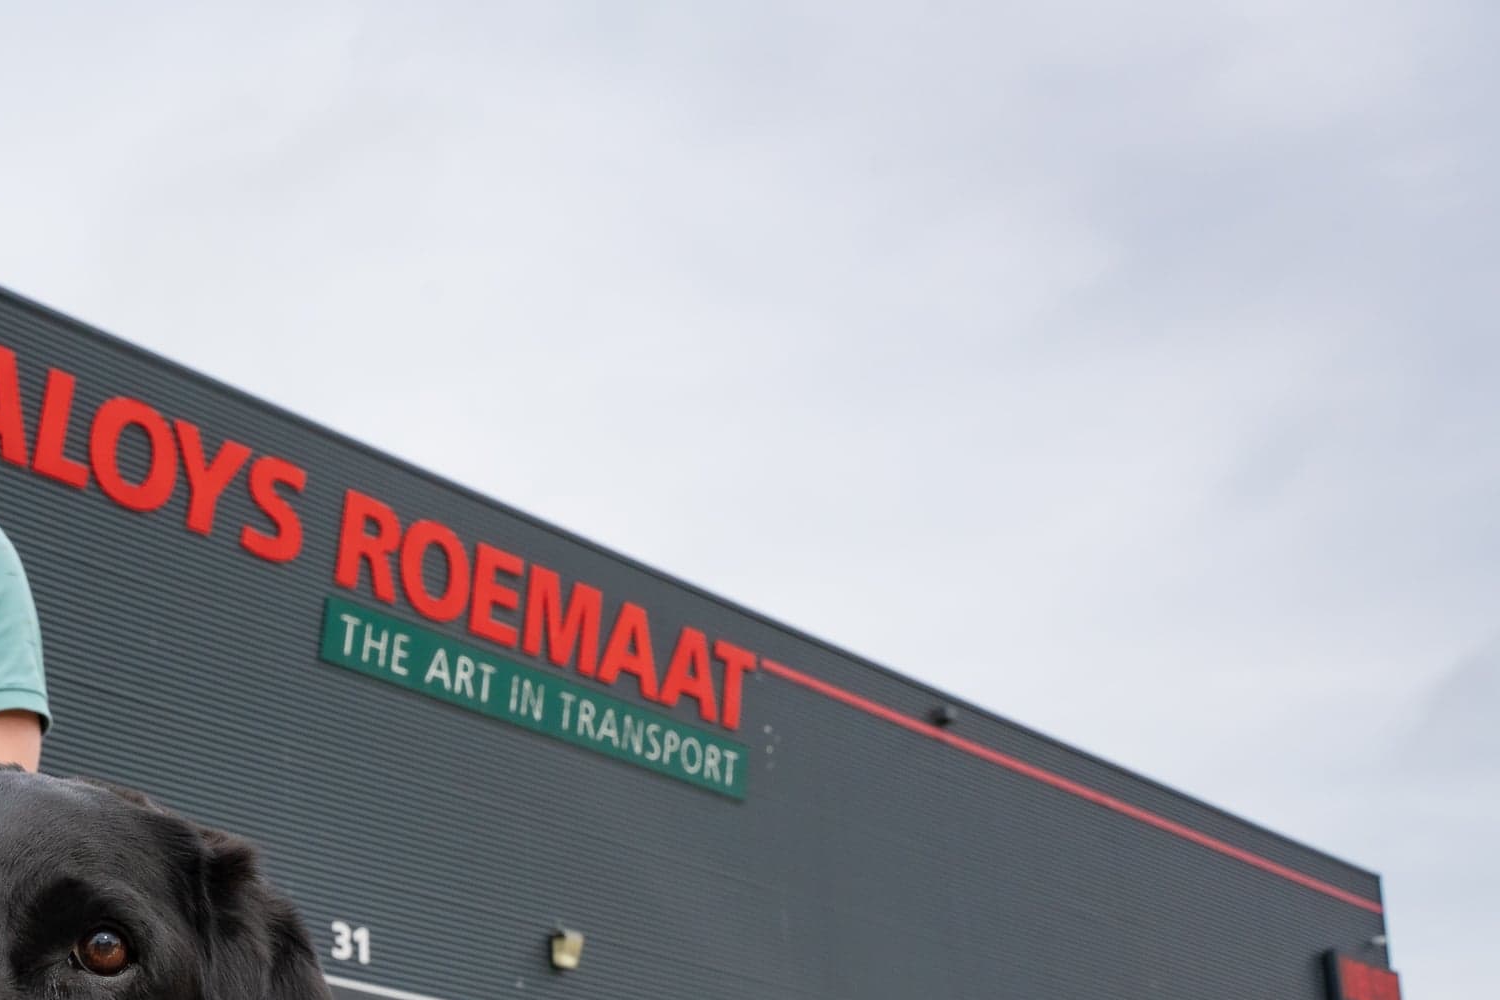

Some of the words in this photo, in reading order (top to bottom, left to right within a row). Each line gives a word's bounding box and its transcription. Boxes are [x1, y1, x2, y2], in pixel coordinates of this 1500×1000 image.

[335, 489, 758, 732] ROEMAAT
[340, 613, 411, 677] THE
[424, 648, 497, 703] ART
[509, 675, 545, 722] IN
[560, 691, 739, 787] TRANSPORT
[331, 920, 370, 965] 31
